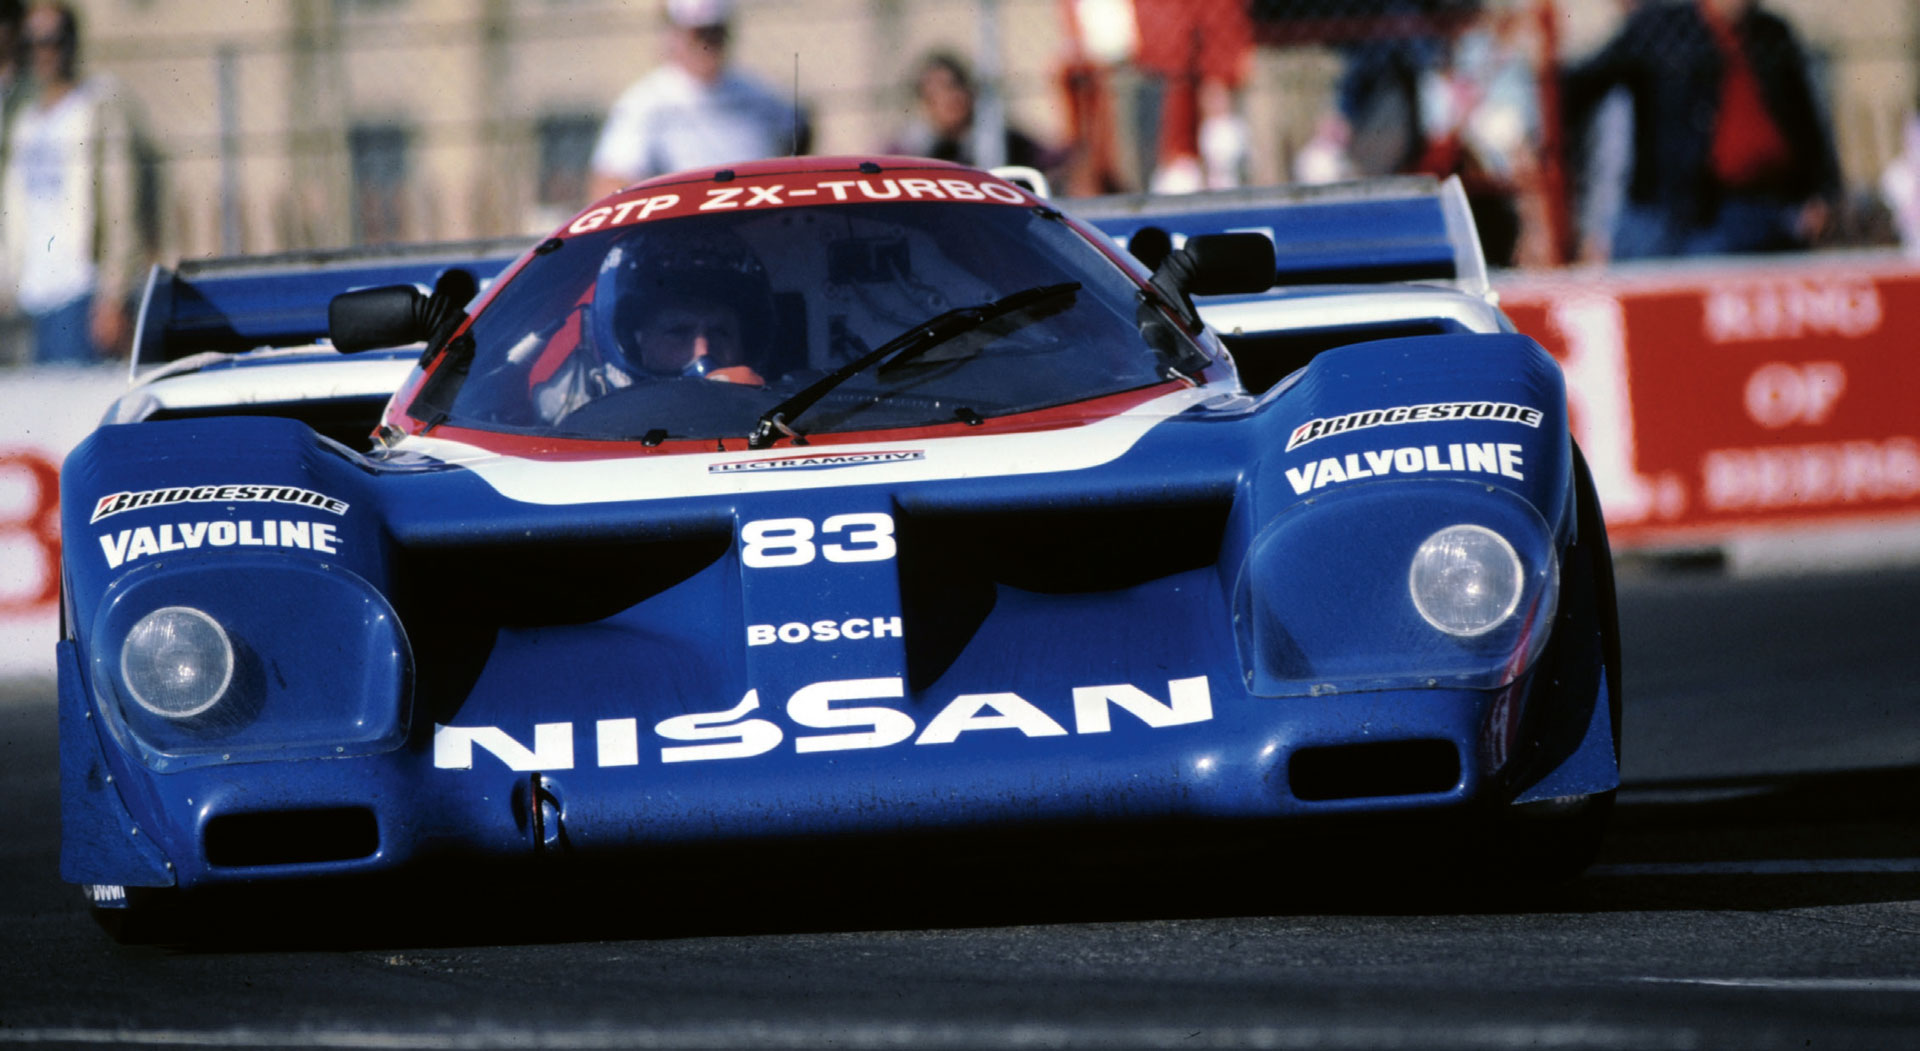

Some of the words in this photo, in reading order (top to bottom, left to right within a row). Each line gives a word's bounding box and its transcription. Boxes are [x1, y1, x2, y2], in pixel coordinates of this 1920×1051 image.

[568, 194, 680, 235] GTP
[699, 179, 1026, 211] ZX-TURBO
[1285, 402, 1543, 452] BRIDGESTONE
[709, 452, 924, 473] ELECTRAMOTIVE
[1285, 443, 1524, 495] VALVOLINE
[90, 484, 350, 524] BRIDGESTONE
[99, 520, 337, 570] VALVOLINE
[741, 512, 897, 569] 83
[747, 616, 903, 646] BOSCH
[434, 675, 1213, 771] NISSAN
